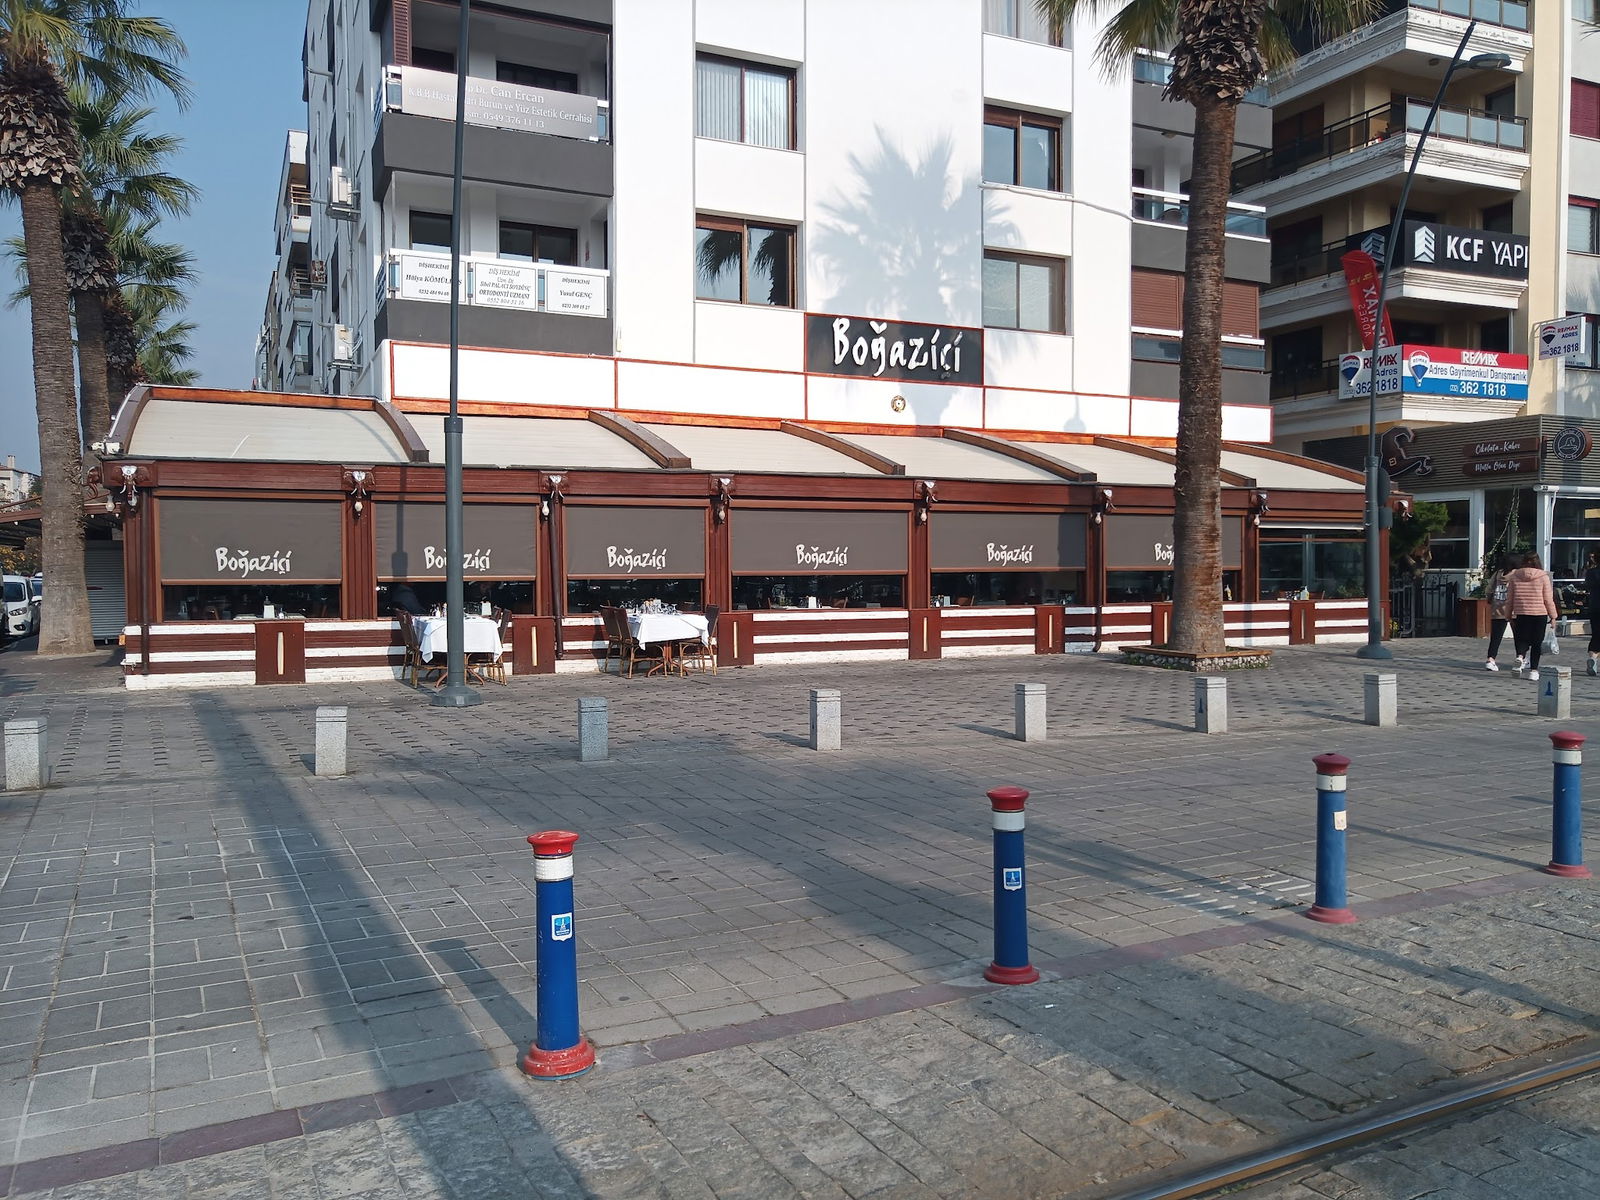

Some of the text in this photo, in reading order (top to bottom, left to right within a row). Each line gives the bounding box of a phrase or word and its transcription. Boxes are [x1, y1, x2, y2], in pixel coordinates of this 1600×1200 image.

[491, 86, 512, 98] Can
[515, 90, 544, 103] Ercan
[479, 99, 503, 110] Burun
[504, 104, 514, 112] ve
[515, 104, 530, 114] Yüz
[531, 106, 558, 119] Estetik
[559, 110, 593, 124] Cerrahisi
[483, 112, 503, 122] 0549
[506, 115, 521, 125] 376
[523, 117, 532, 126] 11
[536, 118, 545, 128] 13
[1446, 235, 1529, 269] KCF YAPI
[832, 317, 963, 379] Boğaziçi
[1549, 345, 1561, 356] 362
[1563, 343, 1579, 353] 1818
[1429, 364, 1447, 375] Adres
[1449, 366, 1489, 379] Gayrimenkul
[1459, 381, 1479, 394] 362
[1482, 383, 1507, 396] 1818
[215, 547, 292, 578] Boğaziçi
[606, 545, 667, 573] Boğaziçi
[795, 544, 848, 569] Boğaziçi
[986, 542, 1033, 566] Boğaziçi
